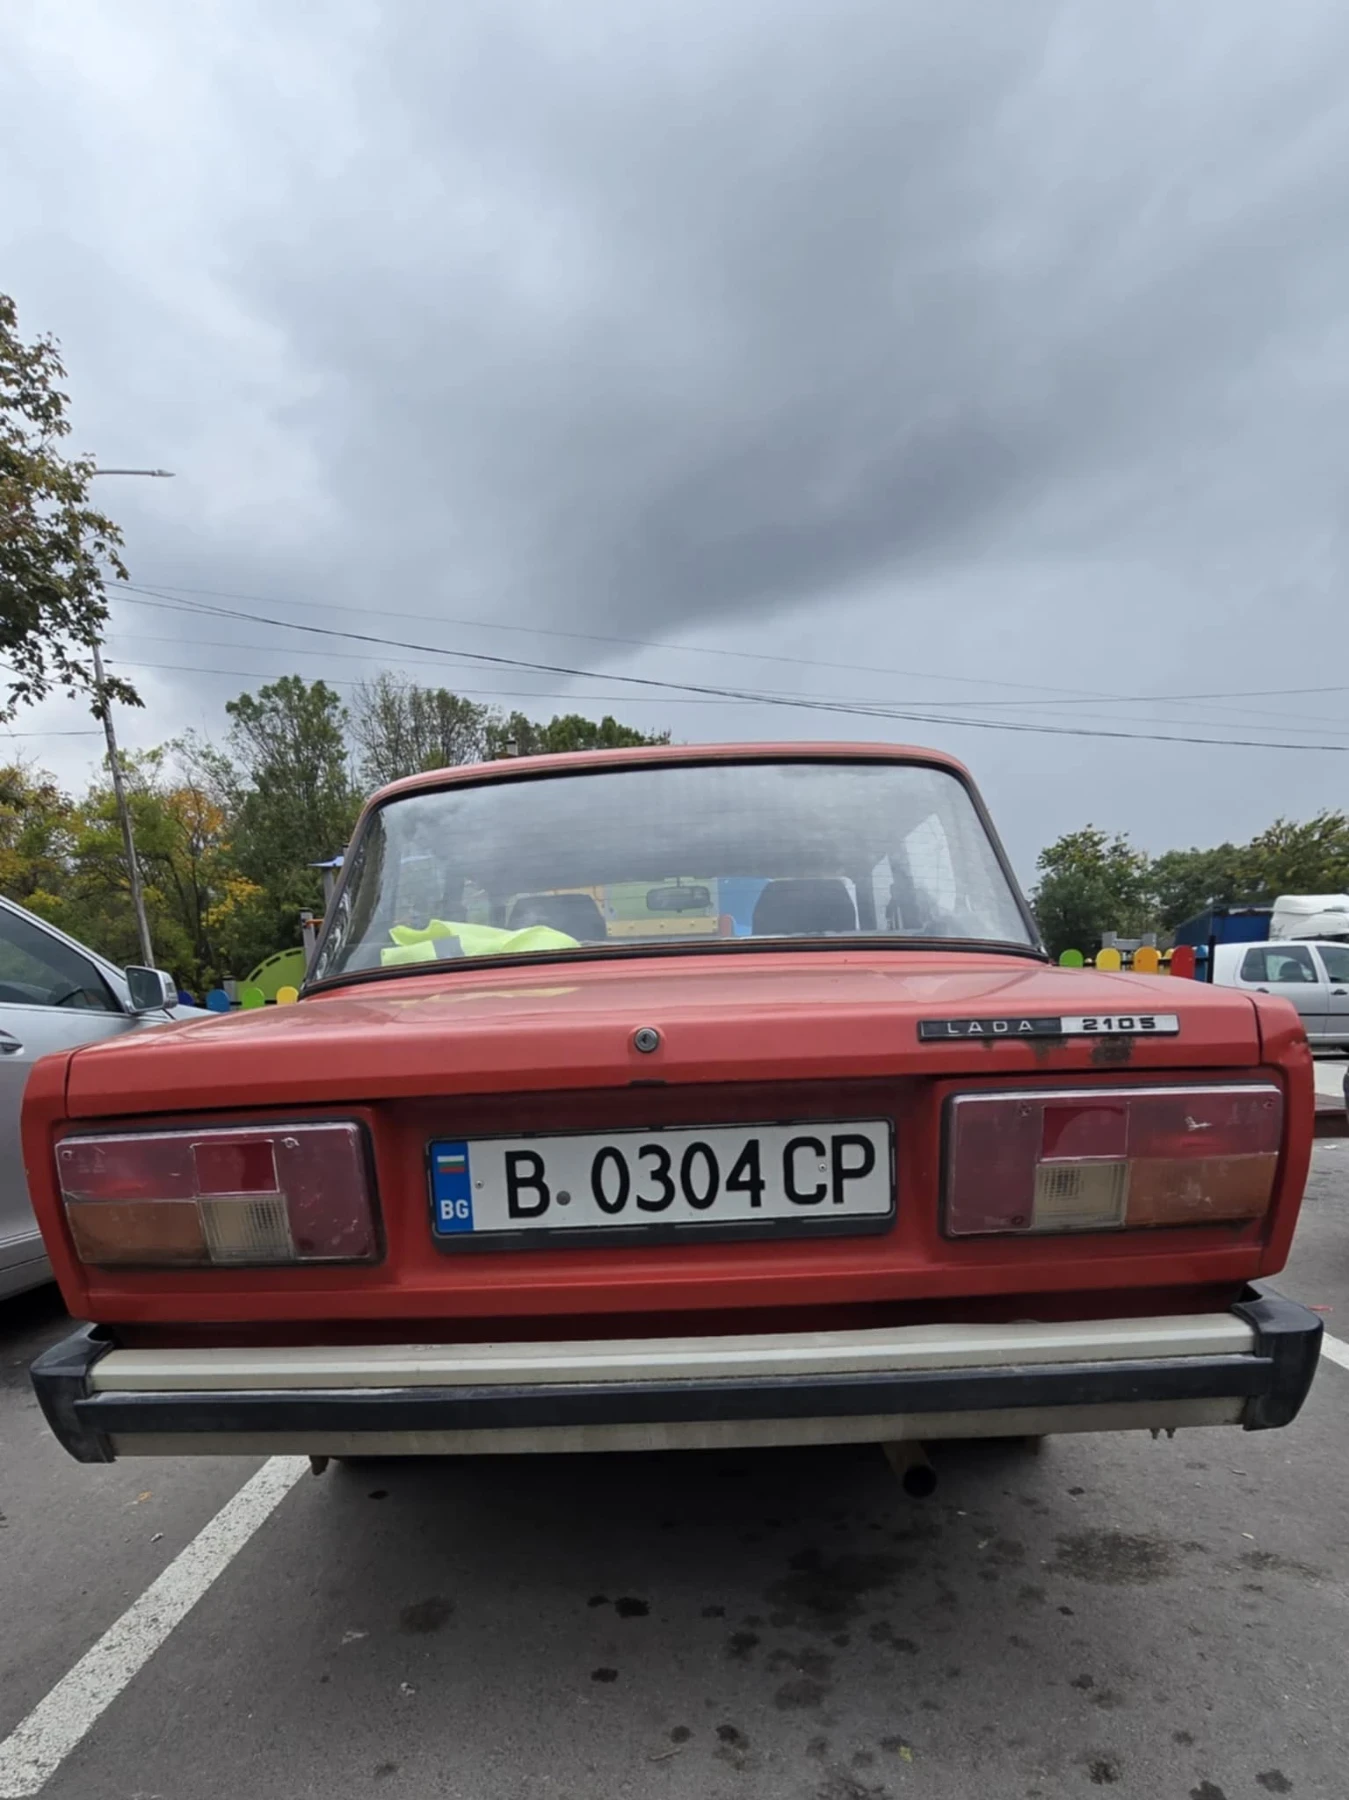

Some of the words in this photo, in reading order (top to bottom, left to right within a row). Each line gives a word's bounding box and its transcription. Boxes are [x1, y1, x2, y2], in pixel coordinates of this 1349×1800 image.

[947, 1020, 1034, 1034] LADA
[1082, 1017, 1156, 1031] 2105
[590, 1138, 766, 1214] 0304
[782, 1133, 876, 1206] CP
[440, 1199, 470, 1220] BG
